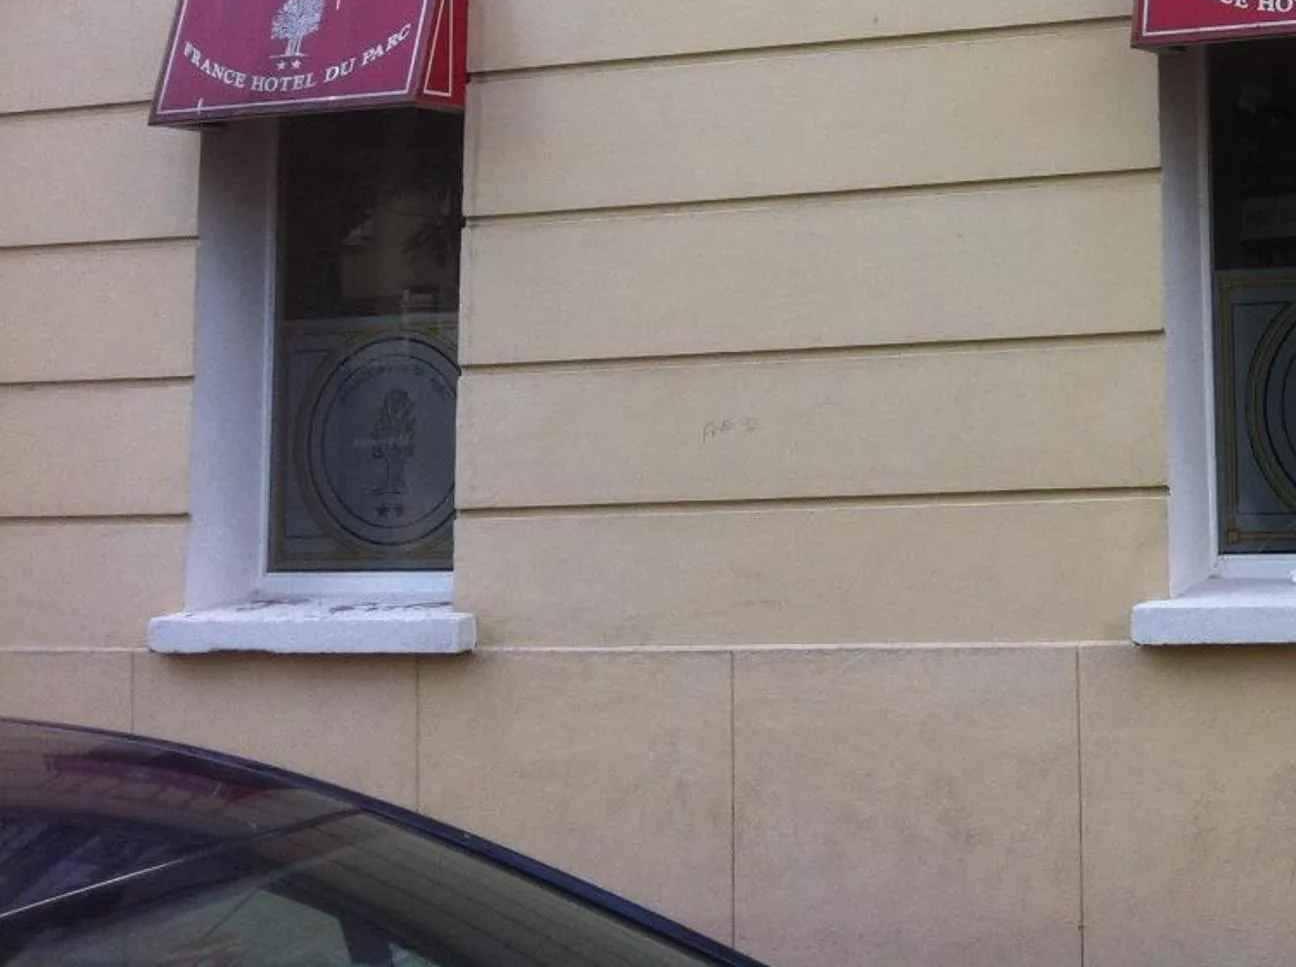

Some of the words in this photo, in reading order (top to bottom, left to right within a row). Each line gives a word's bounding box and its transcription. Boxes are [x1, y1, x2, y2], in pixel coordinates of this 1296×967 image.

[182, 40, 246, 89] FRANCE
[250, 72, 318, 93] HOTEL
[323, 57, 356, 83] DU
[360, 23, 412, 67] PARC
